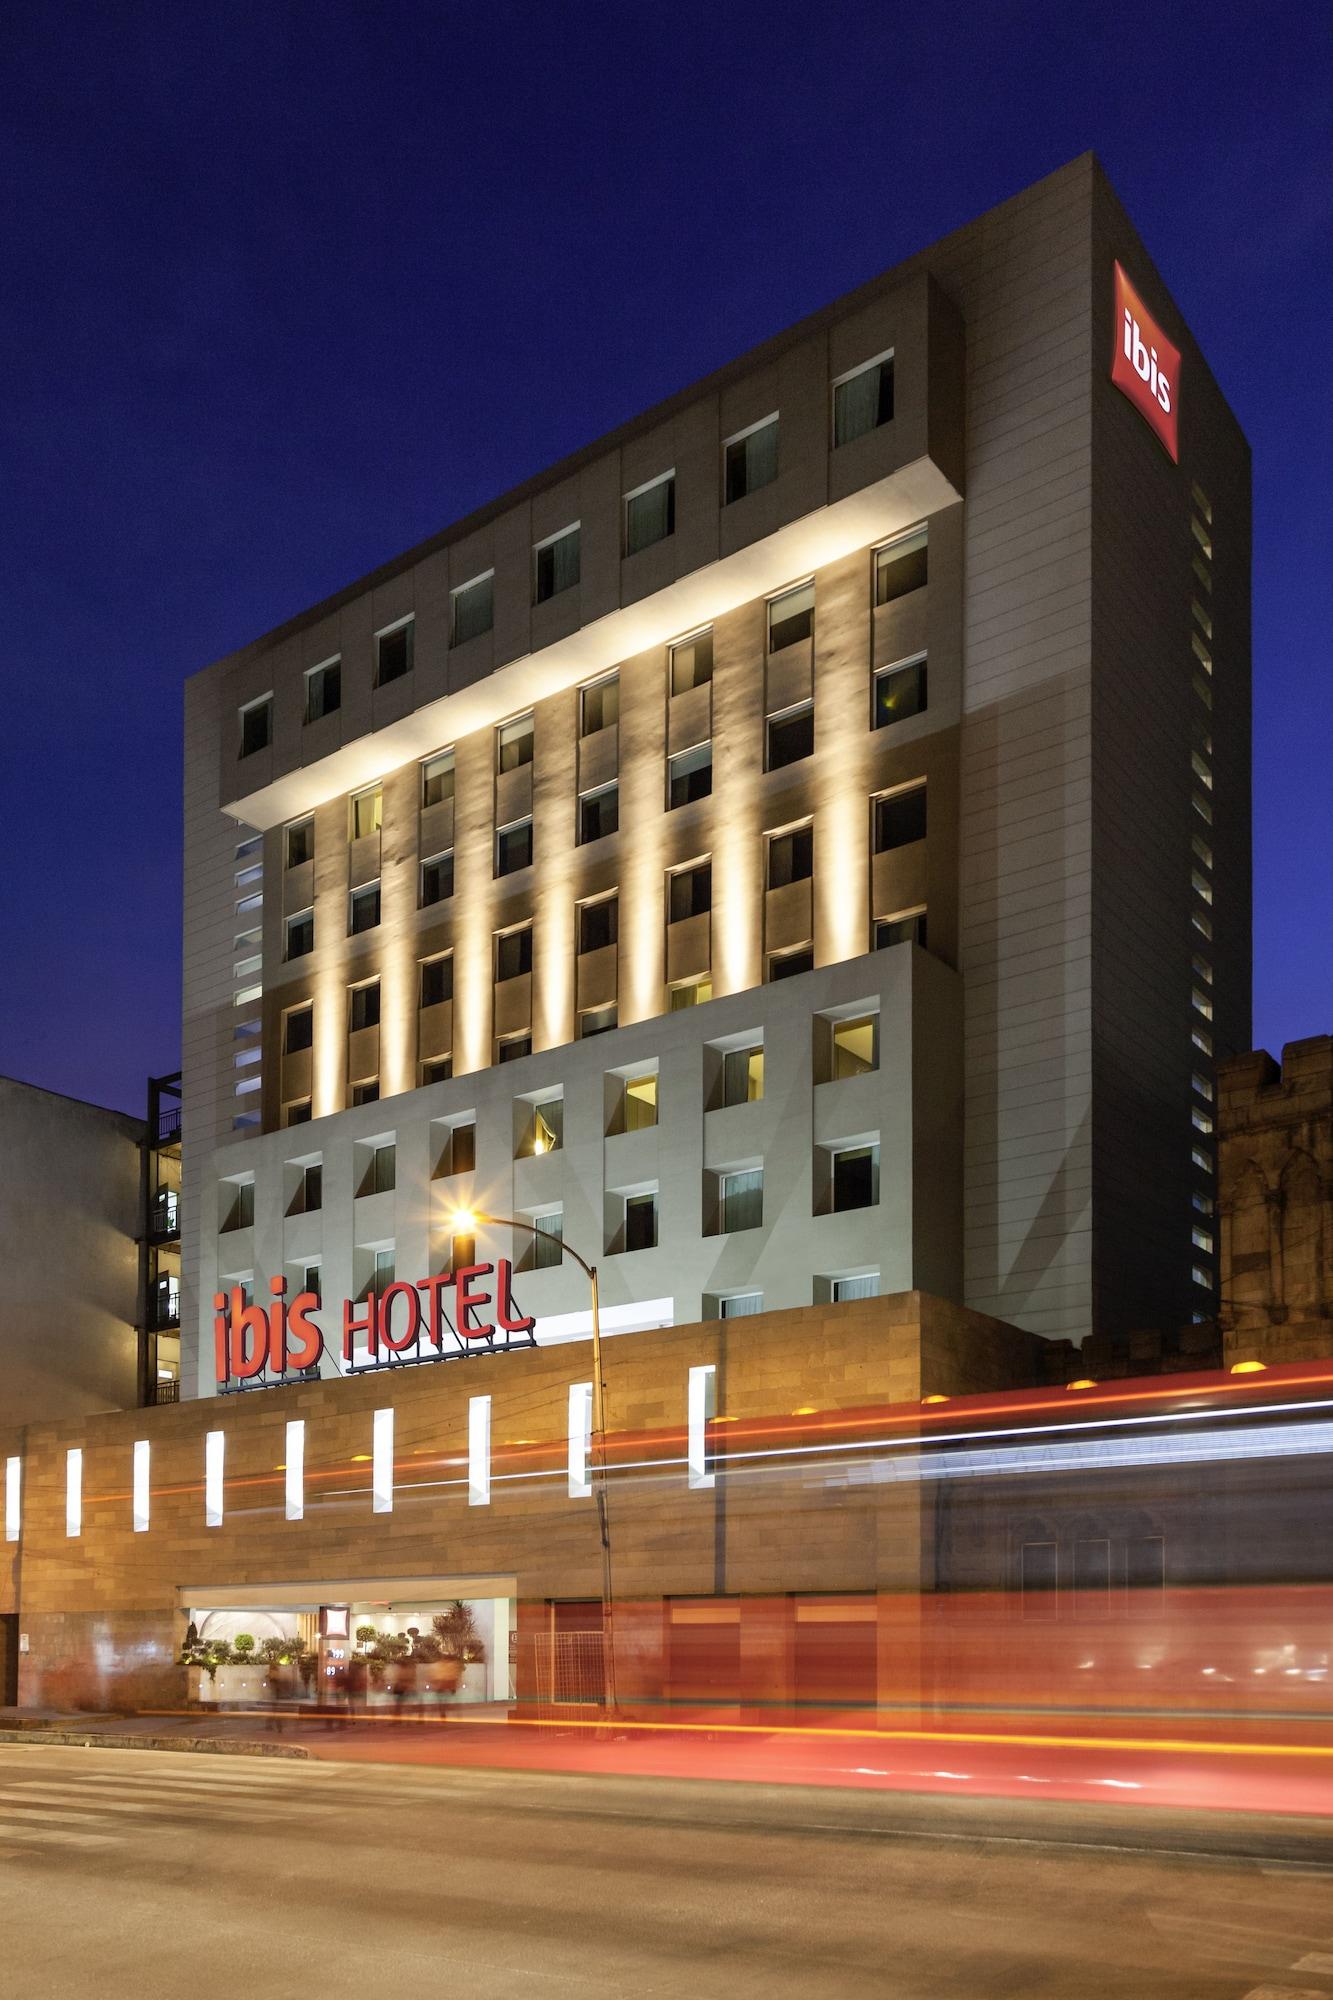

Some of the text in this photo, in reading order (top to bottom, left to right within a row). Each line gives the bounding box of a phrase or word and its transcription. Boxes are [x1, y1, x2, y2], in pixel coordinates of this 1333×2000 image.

[1124, 307, 1171, 414] ibis
[214, 1258, 536, 1382] ibis HOTEL
